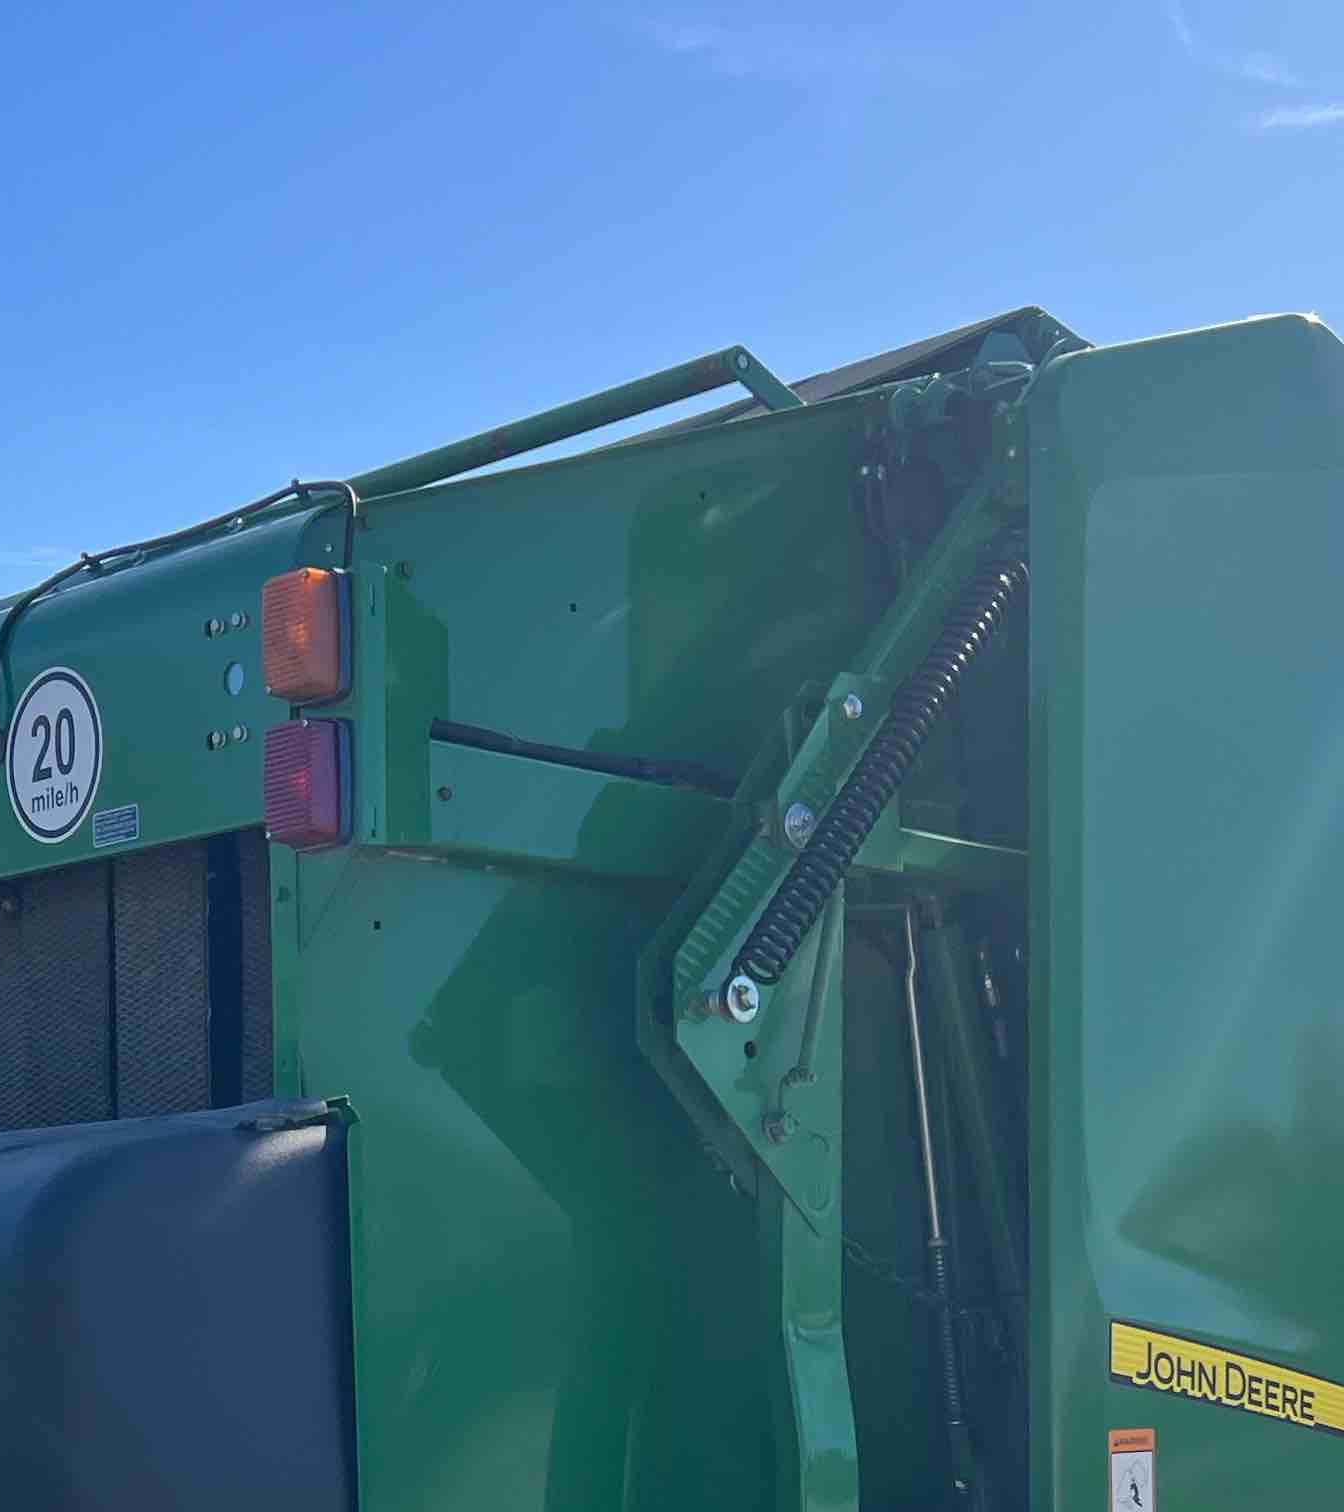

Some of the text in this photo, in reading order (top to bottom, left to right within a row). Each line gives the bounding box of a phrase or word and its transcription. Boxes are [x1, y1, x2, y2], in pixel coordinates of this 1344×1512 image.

[31, 707, 75, 782] 20
[31, 782, 79, 813] mile/h
[1136, 1341, 1315, 1421] JOHN DEERE
